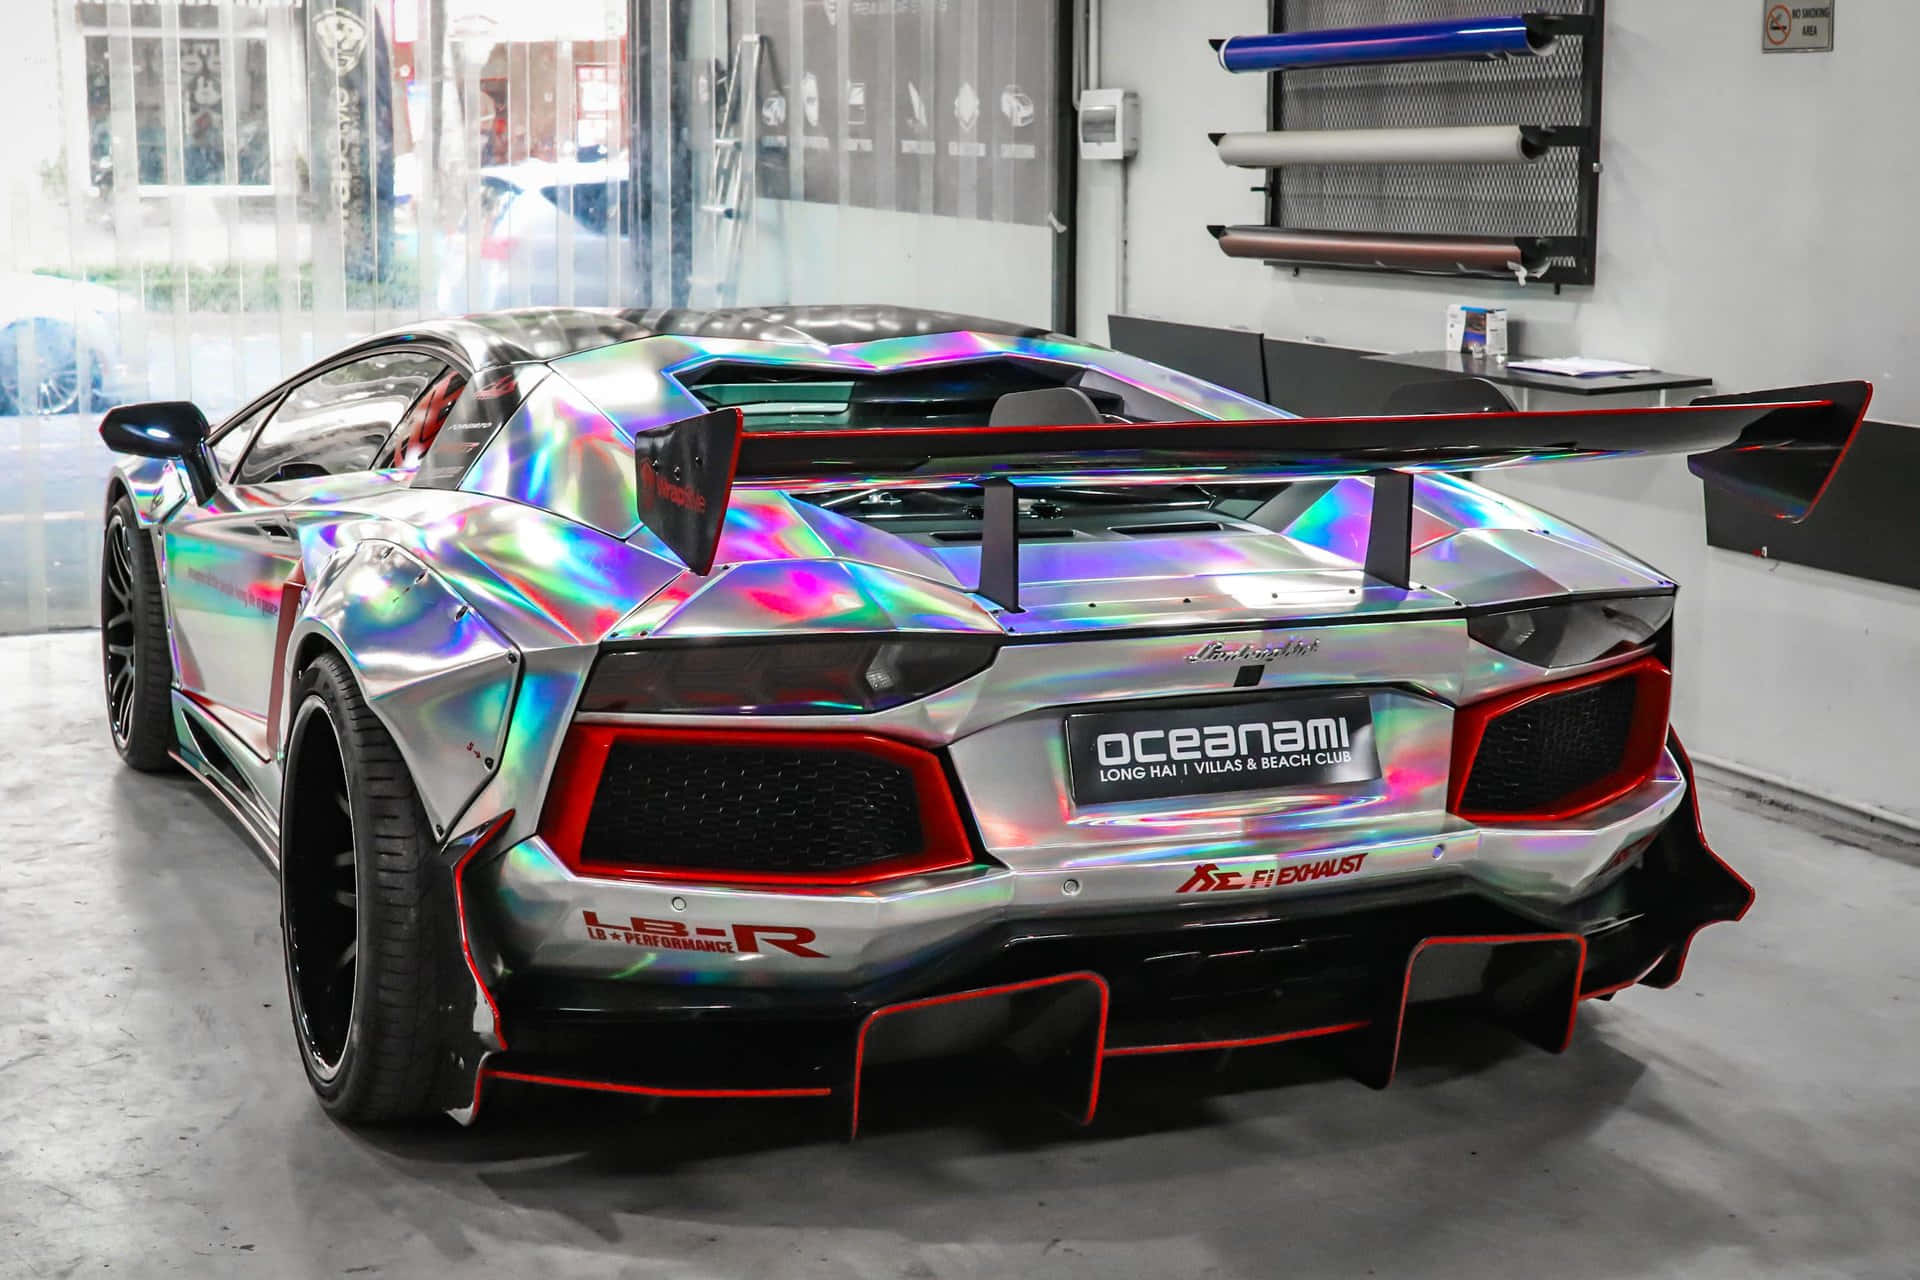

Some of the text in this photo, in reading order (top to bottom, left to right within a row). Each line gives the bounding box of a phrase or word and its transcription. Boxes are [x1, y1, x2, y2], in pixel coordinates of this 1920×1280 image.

[1802, 8, 1831, 18] SMOKING
[1802, 24, 1817, 35] AREA
[1100, 767, 1146, 782] LONG
[1150, 764, 1177, 778] HAI
[1194, 759, 1243, 775] VILLAS
[1247, 758, 1257, 770] &
[1261, 754, 1311, 770] BEACH
[1316, 751, 1352, 765] CLUB
[1276, 853, 1369, 886] EXHAUST
[582, 910, 831, 959] LB-R
[587, 926, 736, 954] LB PERFORMANCE
